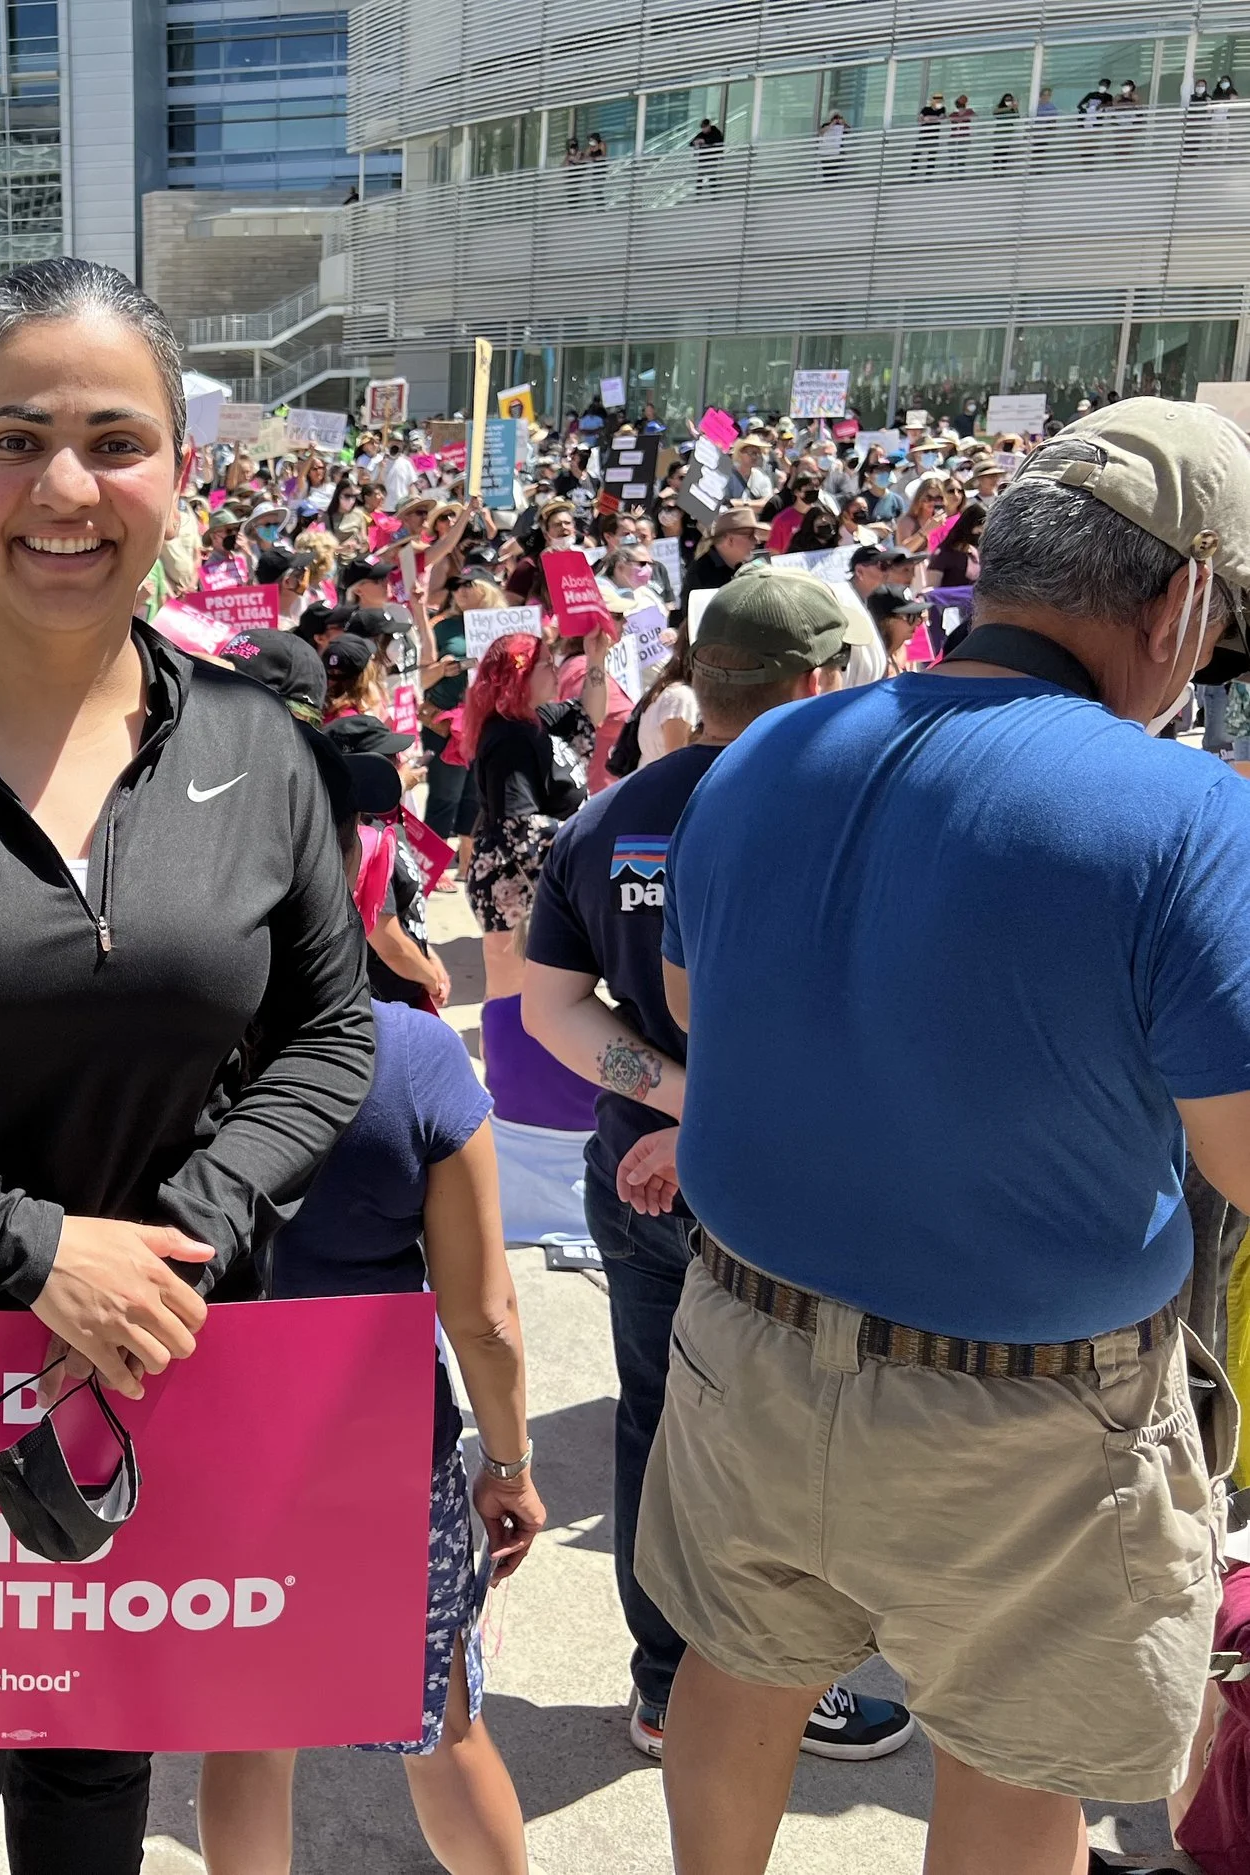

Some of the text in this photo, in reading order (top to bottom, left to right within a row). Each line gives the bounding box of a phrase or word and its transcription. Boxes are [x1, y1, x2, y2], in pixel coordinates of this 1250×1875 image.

[205, 592, 264, 609] PROTECT
[237, 607, 274, 620] LEGAL
[496, 609, 533, 625] GOP
[619, 882, 665, 912] pa
